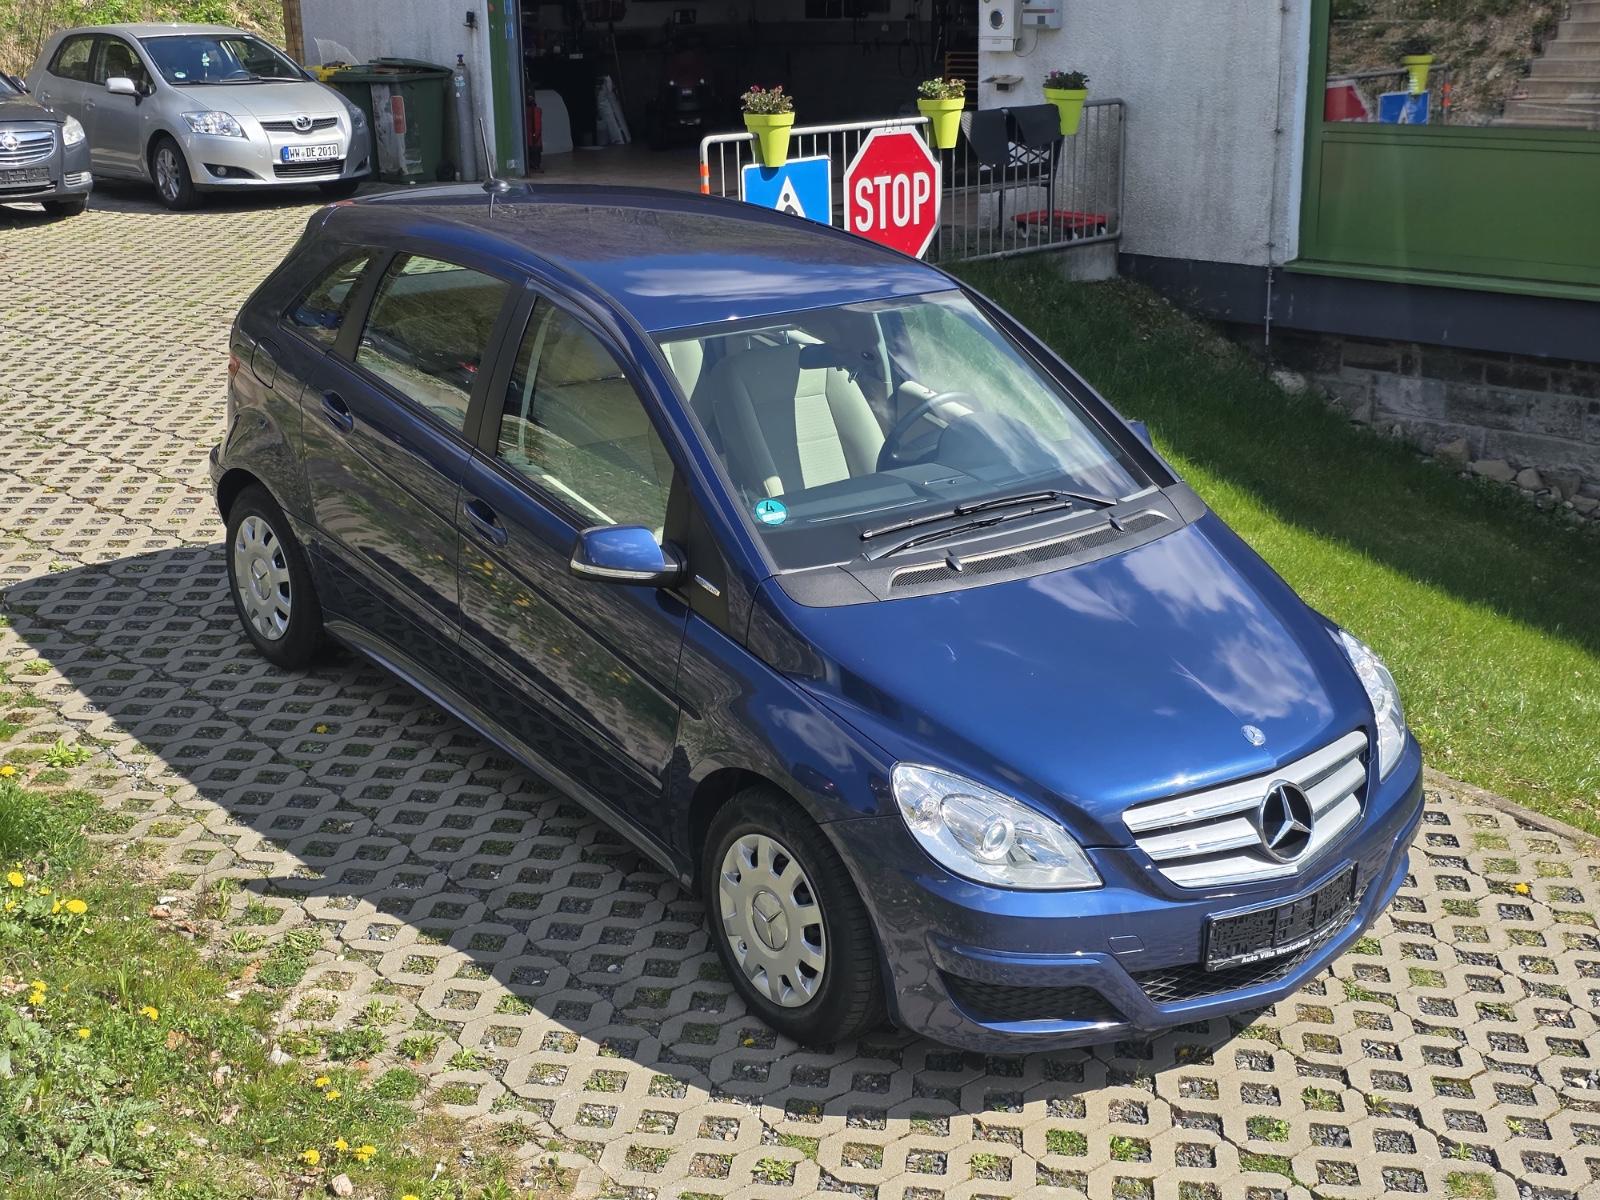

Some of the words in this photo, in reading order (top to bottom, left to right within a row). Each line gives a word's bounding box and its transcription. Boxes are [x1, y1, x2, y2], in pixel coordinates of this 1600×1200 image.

[289, 148, 300, 158] WW
[306, 147, 316, 157] DE
[318, 145, 337, 156] 2018
[855, 171, 931, 232] STOP
[766, 501, 775, 513] 4
[1241, 955, 1259, 964] Auto
[1260, 949, 1276, 959] Villa
[1276, 938, 1311, 955] Westerburg
